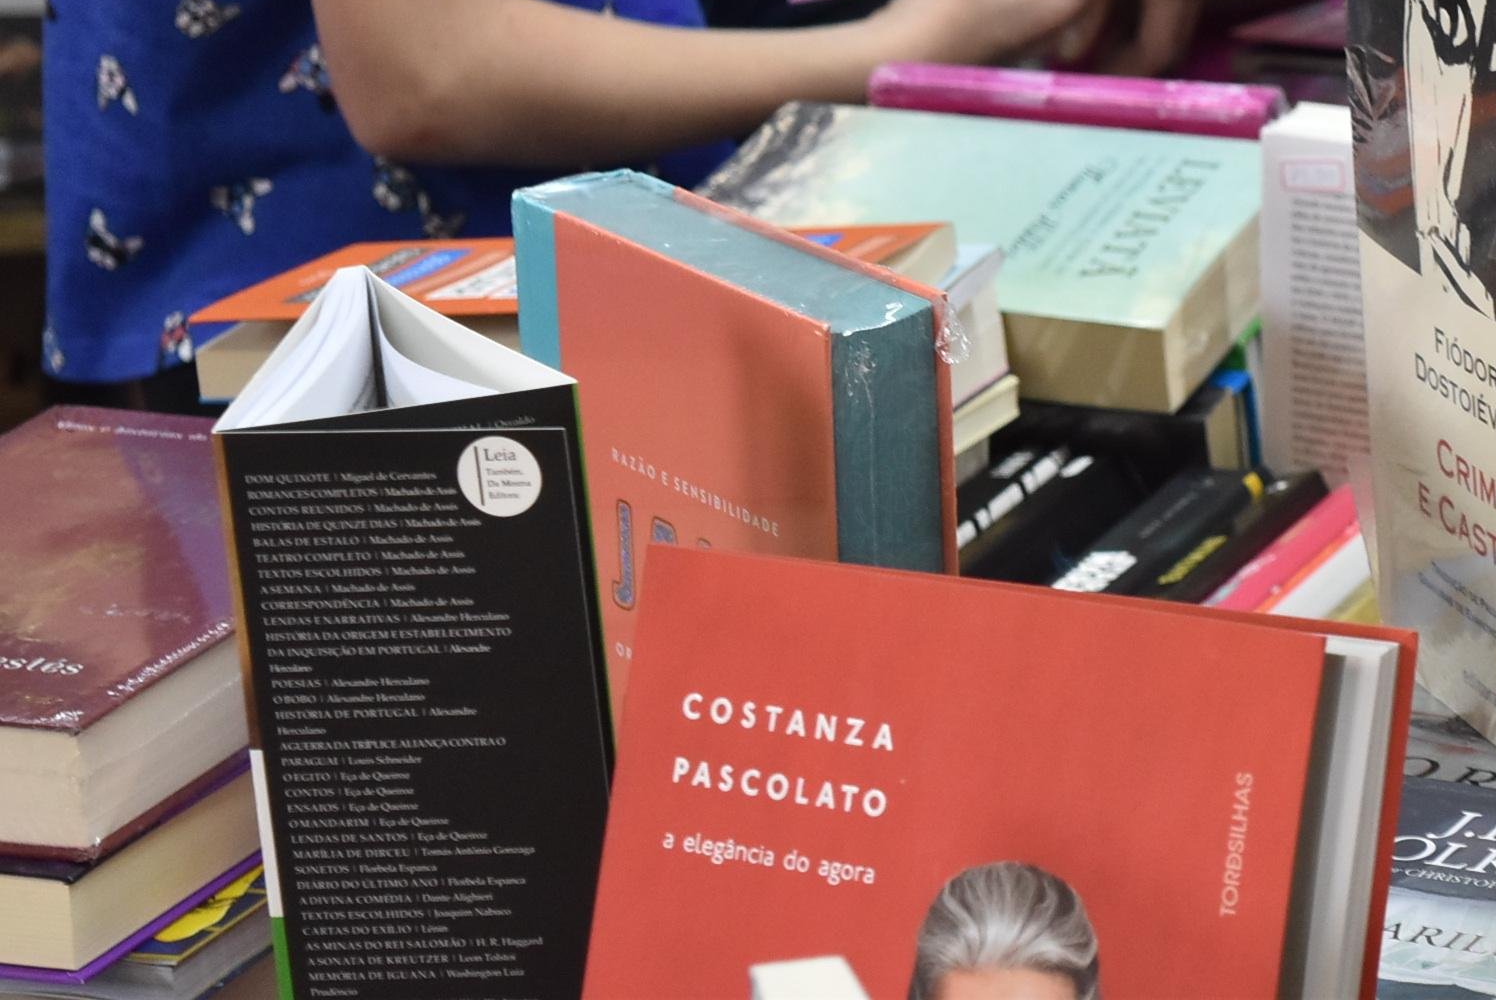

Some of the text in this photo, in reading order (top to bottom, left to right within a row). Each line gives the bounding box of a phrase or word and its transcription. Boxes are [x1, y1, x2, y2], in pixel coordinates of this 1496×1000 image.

[483, 448, 517, 462] Leia
[611, 447, 780, 538] RAZÃO E SENSIBILIDADE
[1418, 481, 1433, 518] E
[681, 692, 895, 753] COSTANZA
[671, 757, 888, 818] PASCOLATO
[662, 829, 875, 886] a elegância do agora
